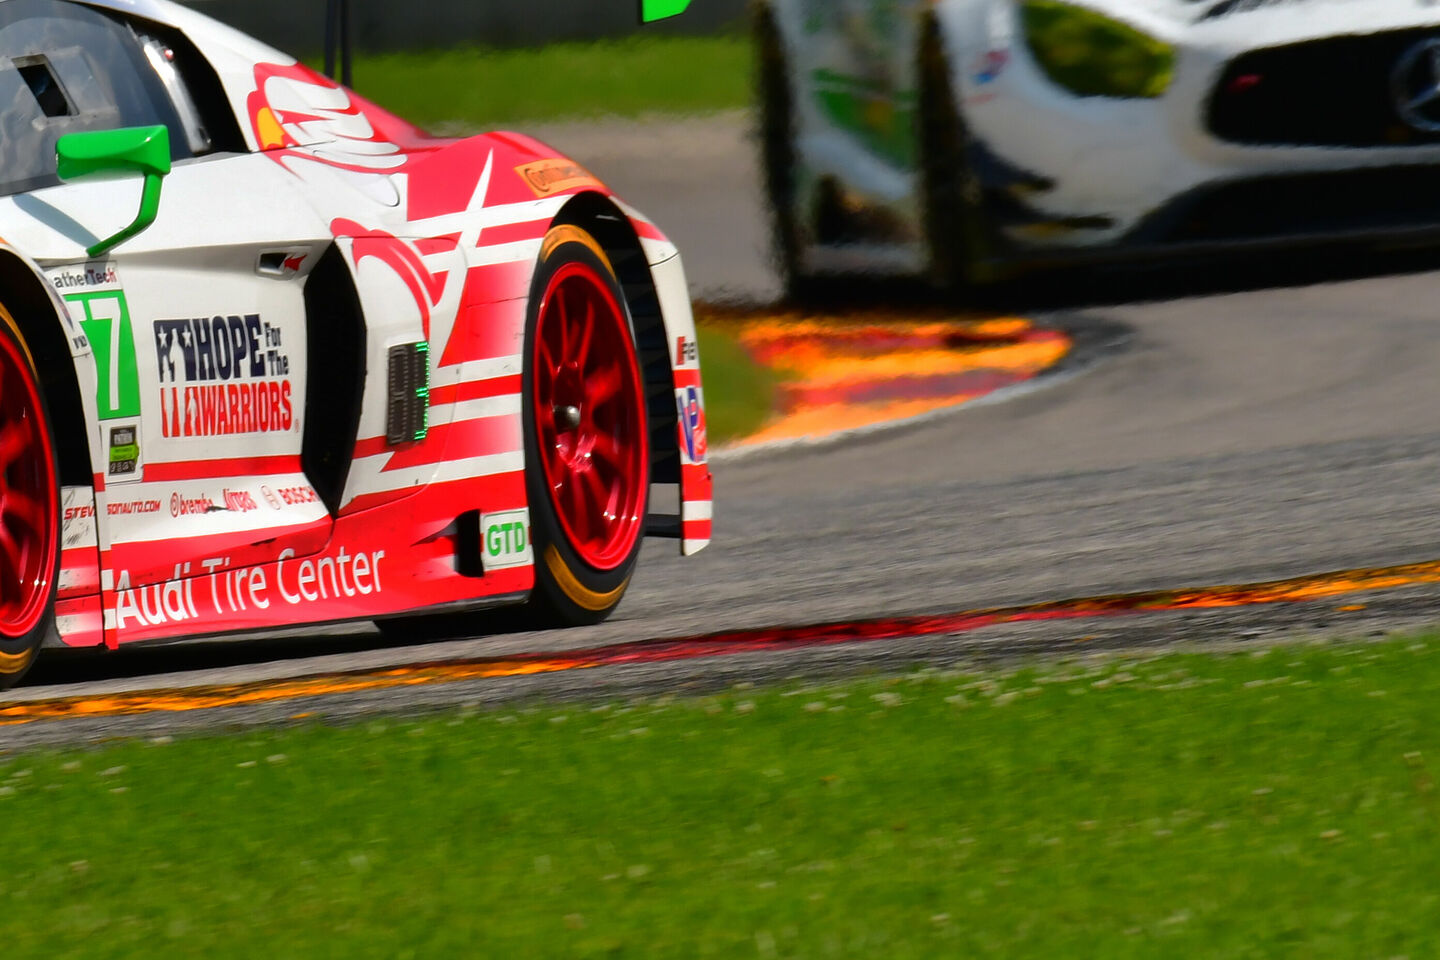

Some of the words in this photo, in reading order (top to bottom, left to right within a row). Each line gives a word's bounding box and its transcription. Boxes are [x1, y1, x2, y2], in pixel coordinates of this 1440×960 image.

[54, 268, 118, 289] atherTech
[192, 313, 266, 382] HOPE
[263, 322, 282, 348] For
[267, 349, 289, 377] The
[200, 379, 293, 437] WARRIORS
[486, 521, 527, 557] GTD
[115, 561, 199, 630] Audi
[201, 556, 270, 614] Tire
[277, 545, 386, 605] Center
